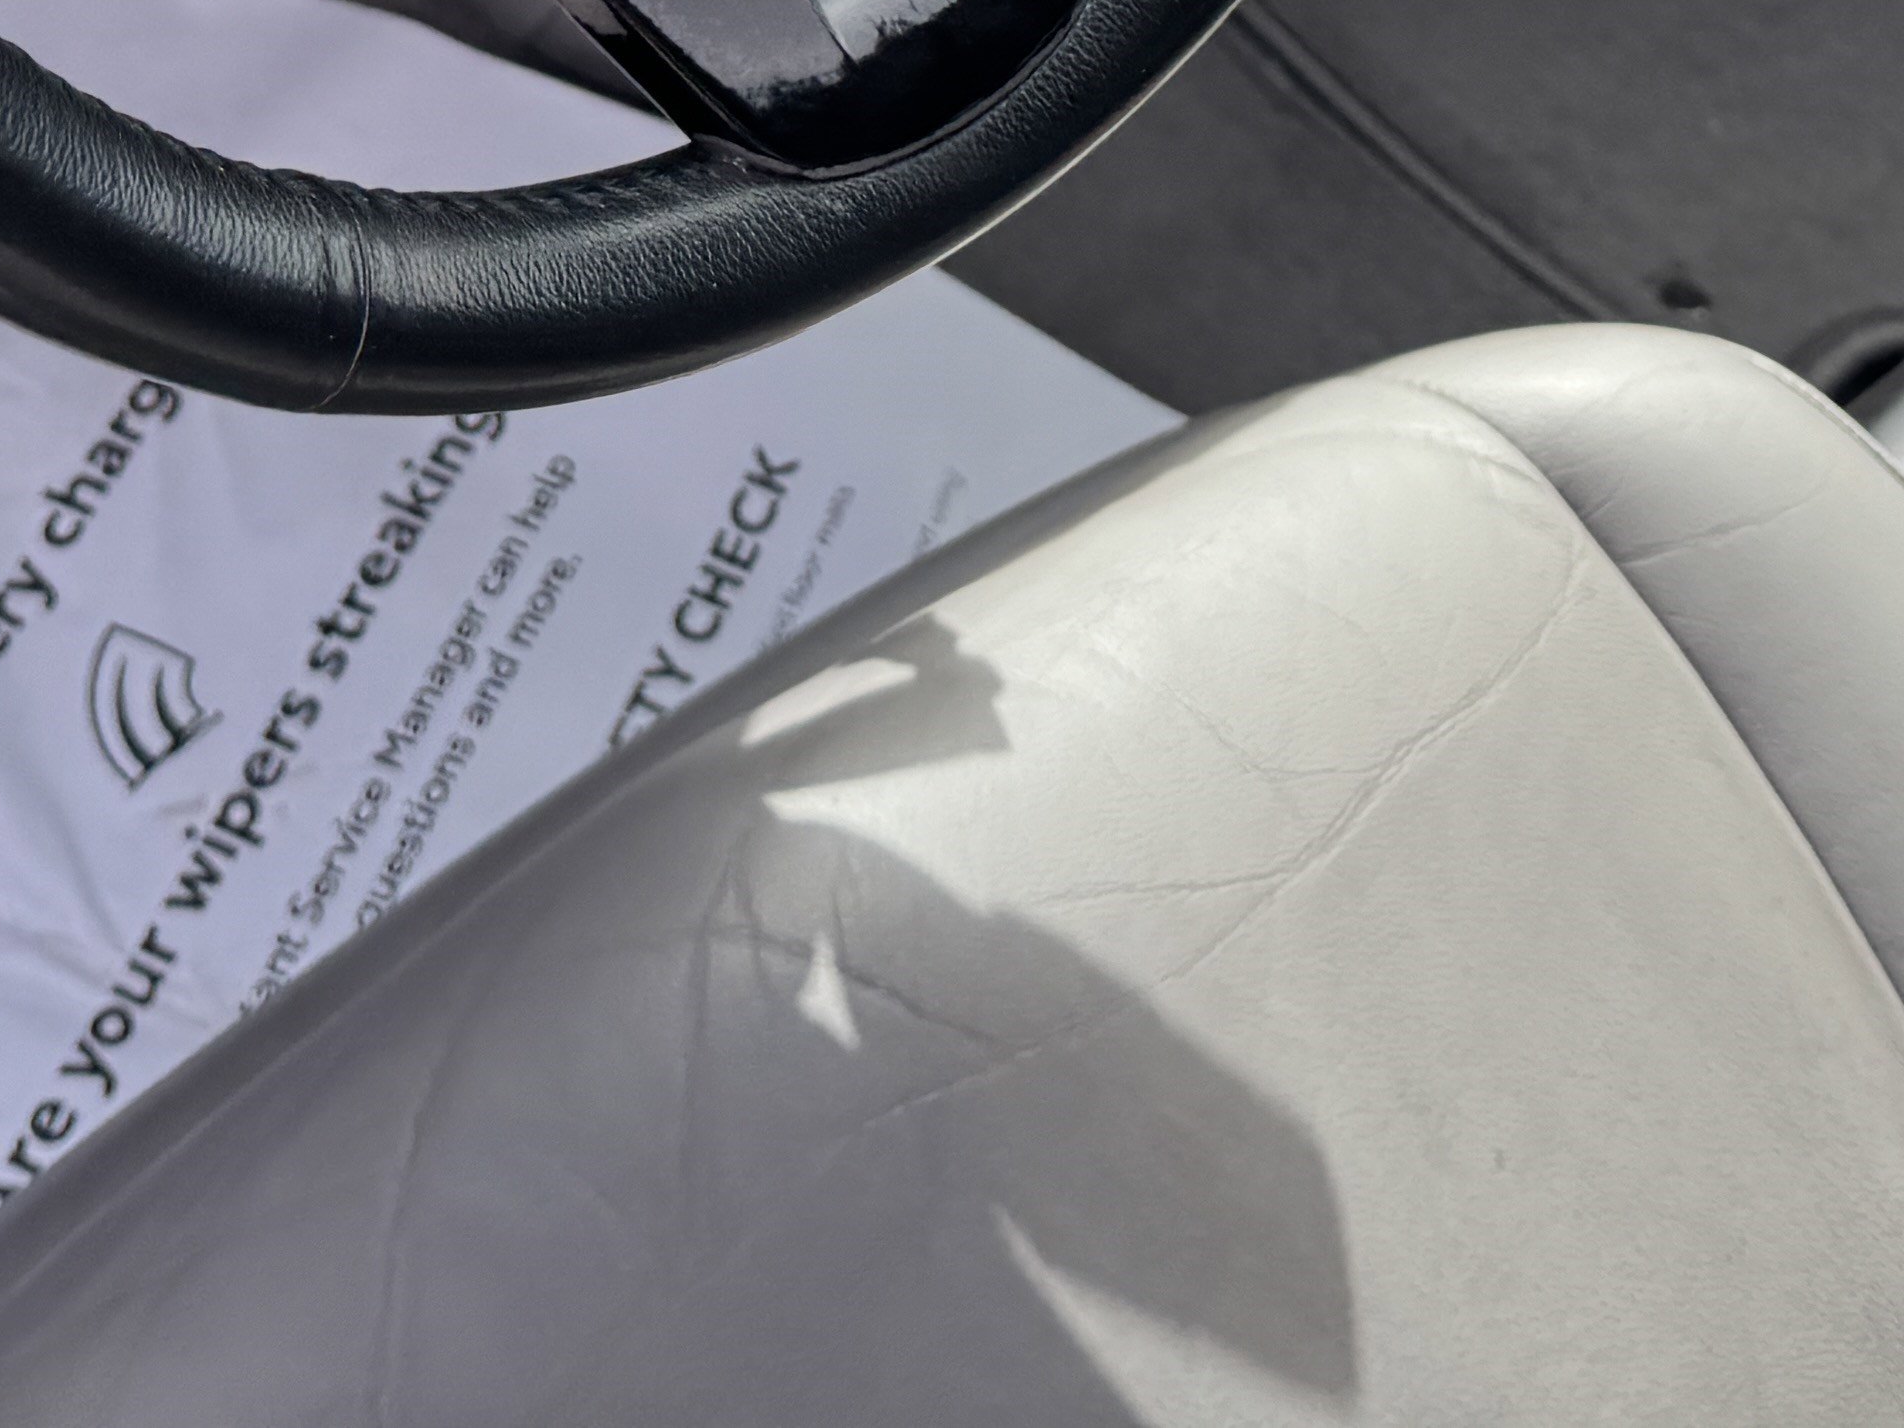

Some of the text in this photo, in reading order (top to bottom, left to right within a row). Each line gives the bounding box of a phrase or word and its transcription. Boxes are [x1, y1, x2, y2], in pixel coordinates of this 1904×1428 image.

[41, 378, 185, 547] charg
[673, 443, 802, 643] CHECK
[57, 924, 179, 1099] your
[163, 686, 323, 911] wipers
[306, 412, 507, 684] streaking
[288, 777, 392, 927] Service
[372, 598, 488, 770] Manager
[477, 535, 529, 600] can
[508, 453, 577, 532] help
[356, 552, 584, 931] questions and more.
